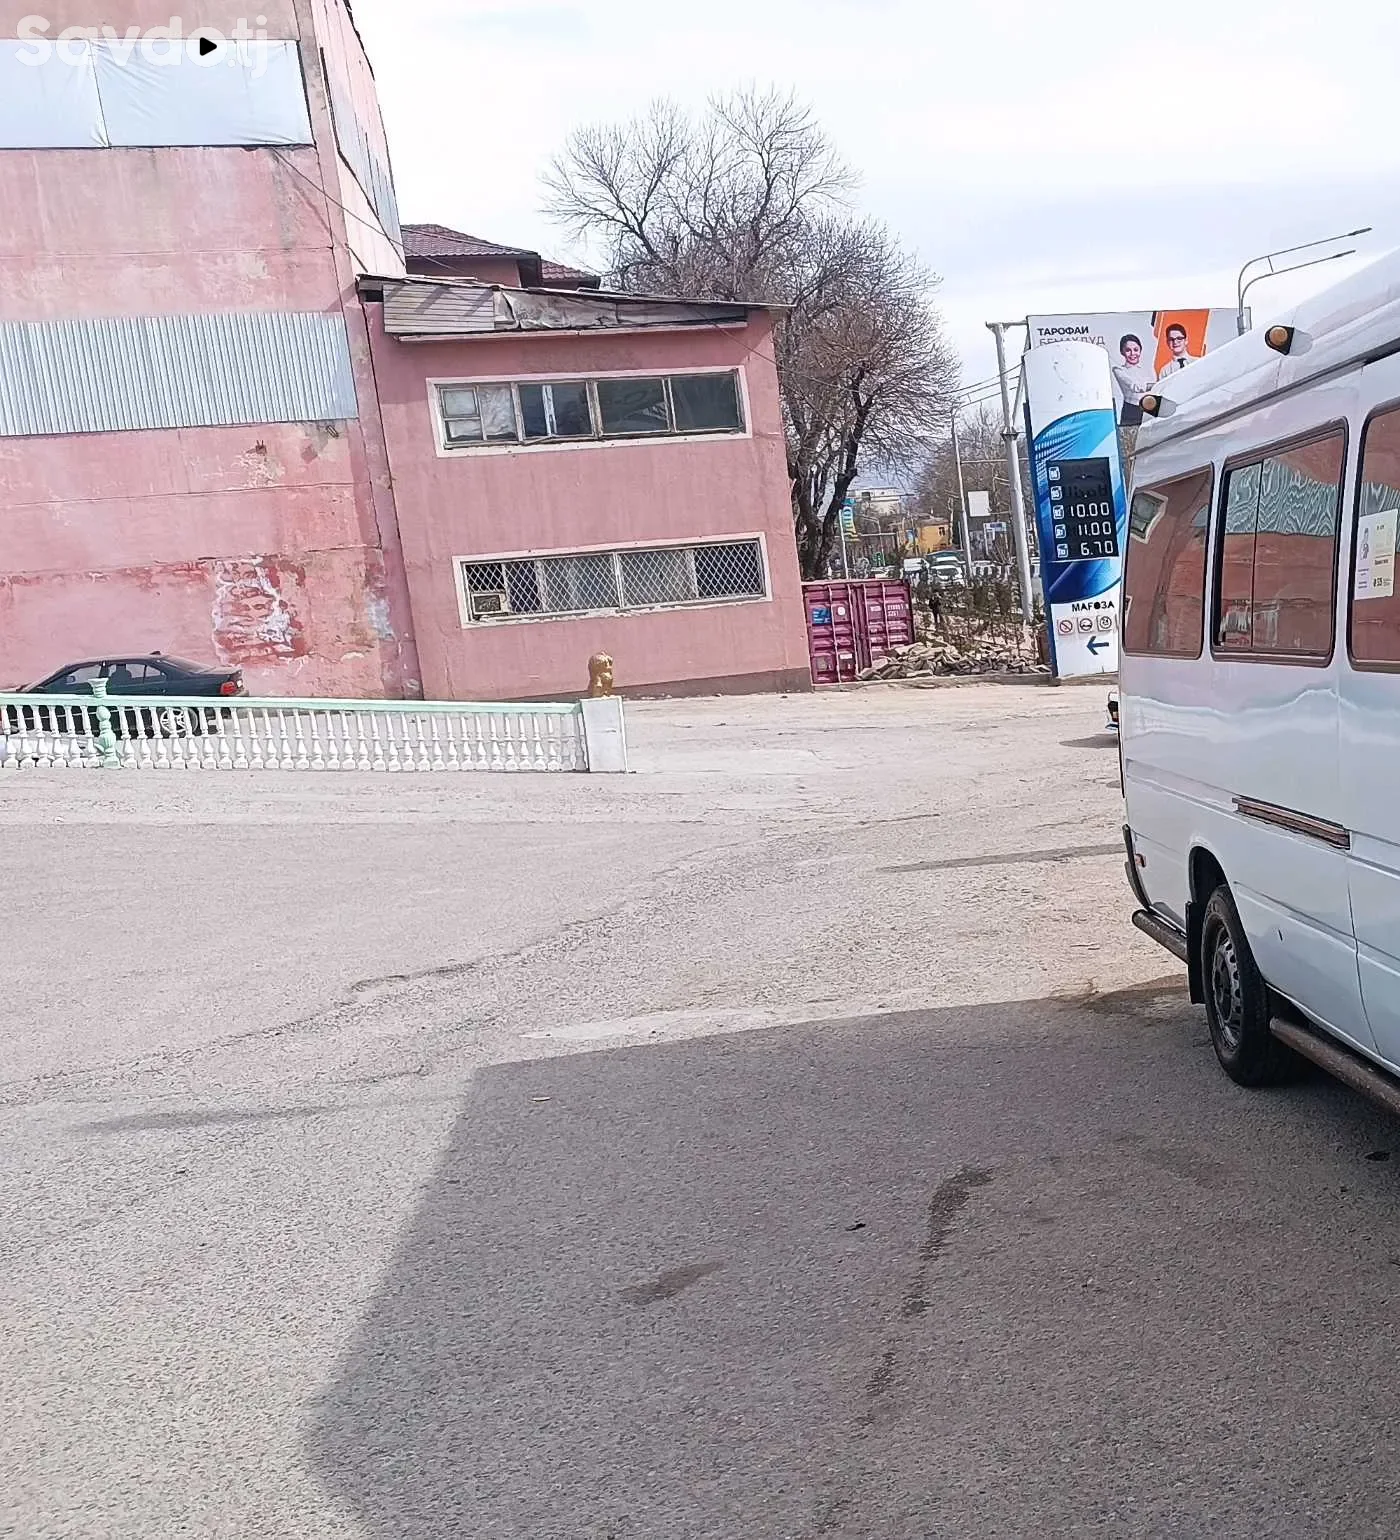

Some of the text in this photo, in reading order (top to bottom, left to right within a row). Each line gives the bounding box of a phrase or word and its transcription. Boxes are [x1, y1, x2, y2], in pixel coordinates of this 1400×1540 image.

[1070, 502, 1110, 518] 10.00
[1078, 521, 1112, 537] 11.00
[1080, 540, 1114, 556] 6.70
